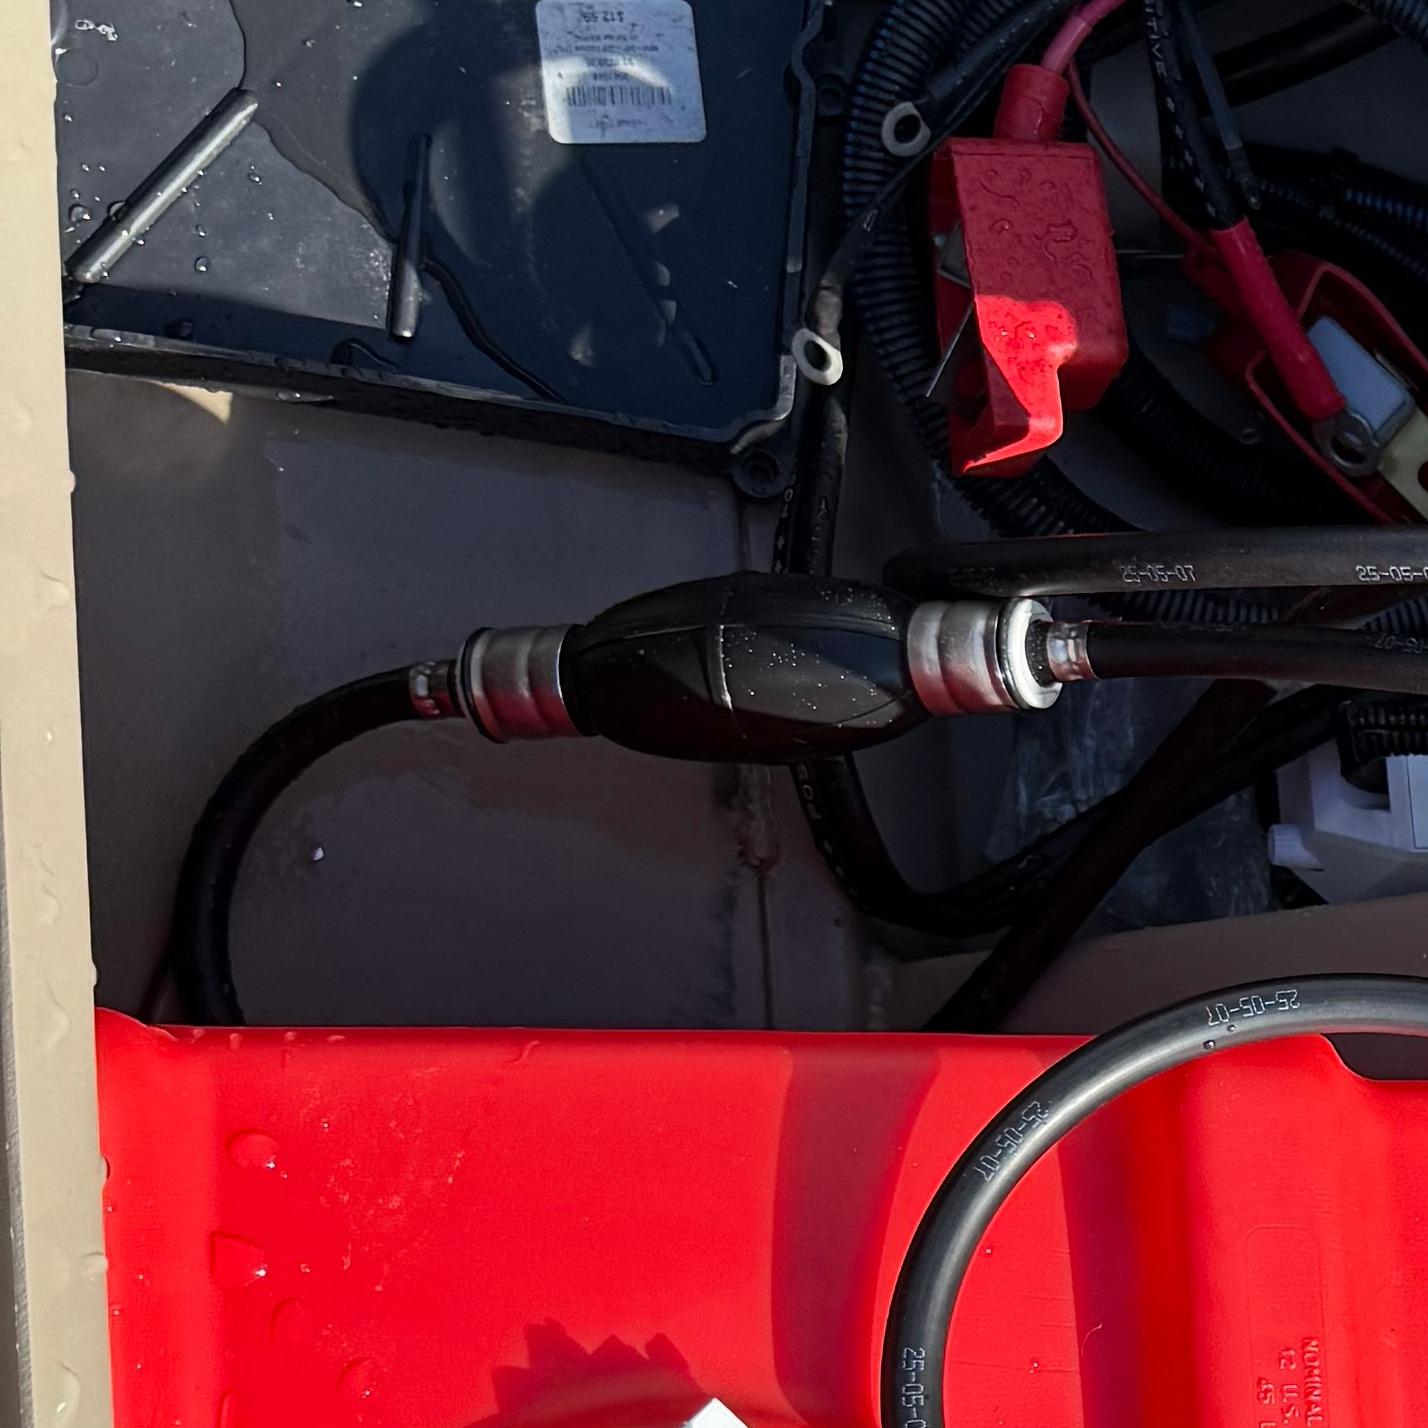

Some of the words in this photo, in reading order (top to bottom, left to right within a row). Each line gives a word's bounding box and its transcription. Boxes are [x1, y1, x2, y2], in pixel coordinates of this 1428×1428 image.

[1121, 564, 1196, 583] 25-05-07
[1206, 989, 1301, 1027] 25-05-07
[974, 1100, 1049, 1183] 25-05-07
[1301, 1336, 1323, 1427] NOMINAL
